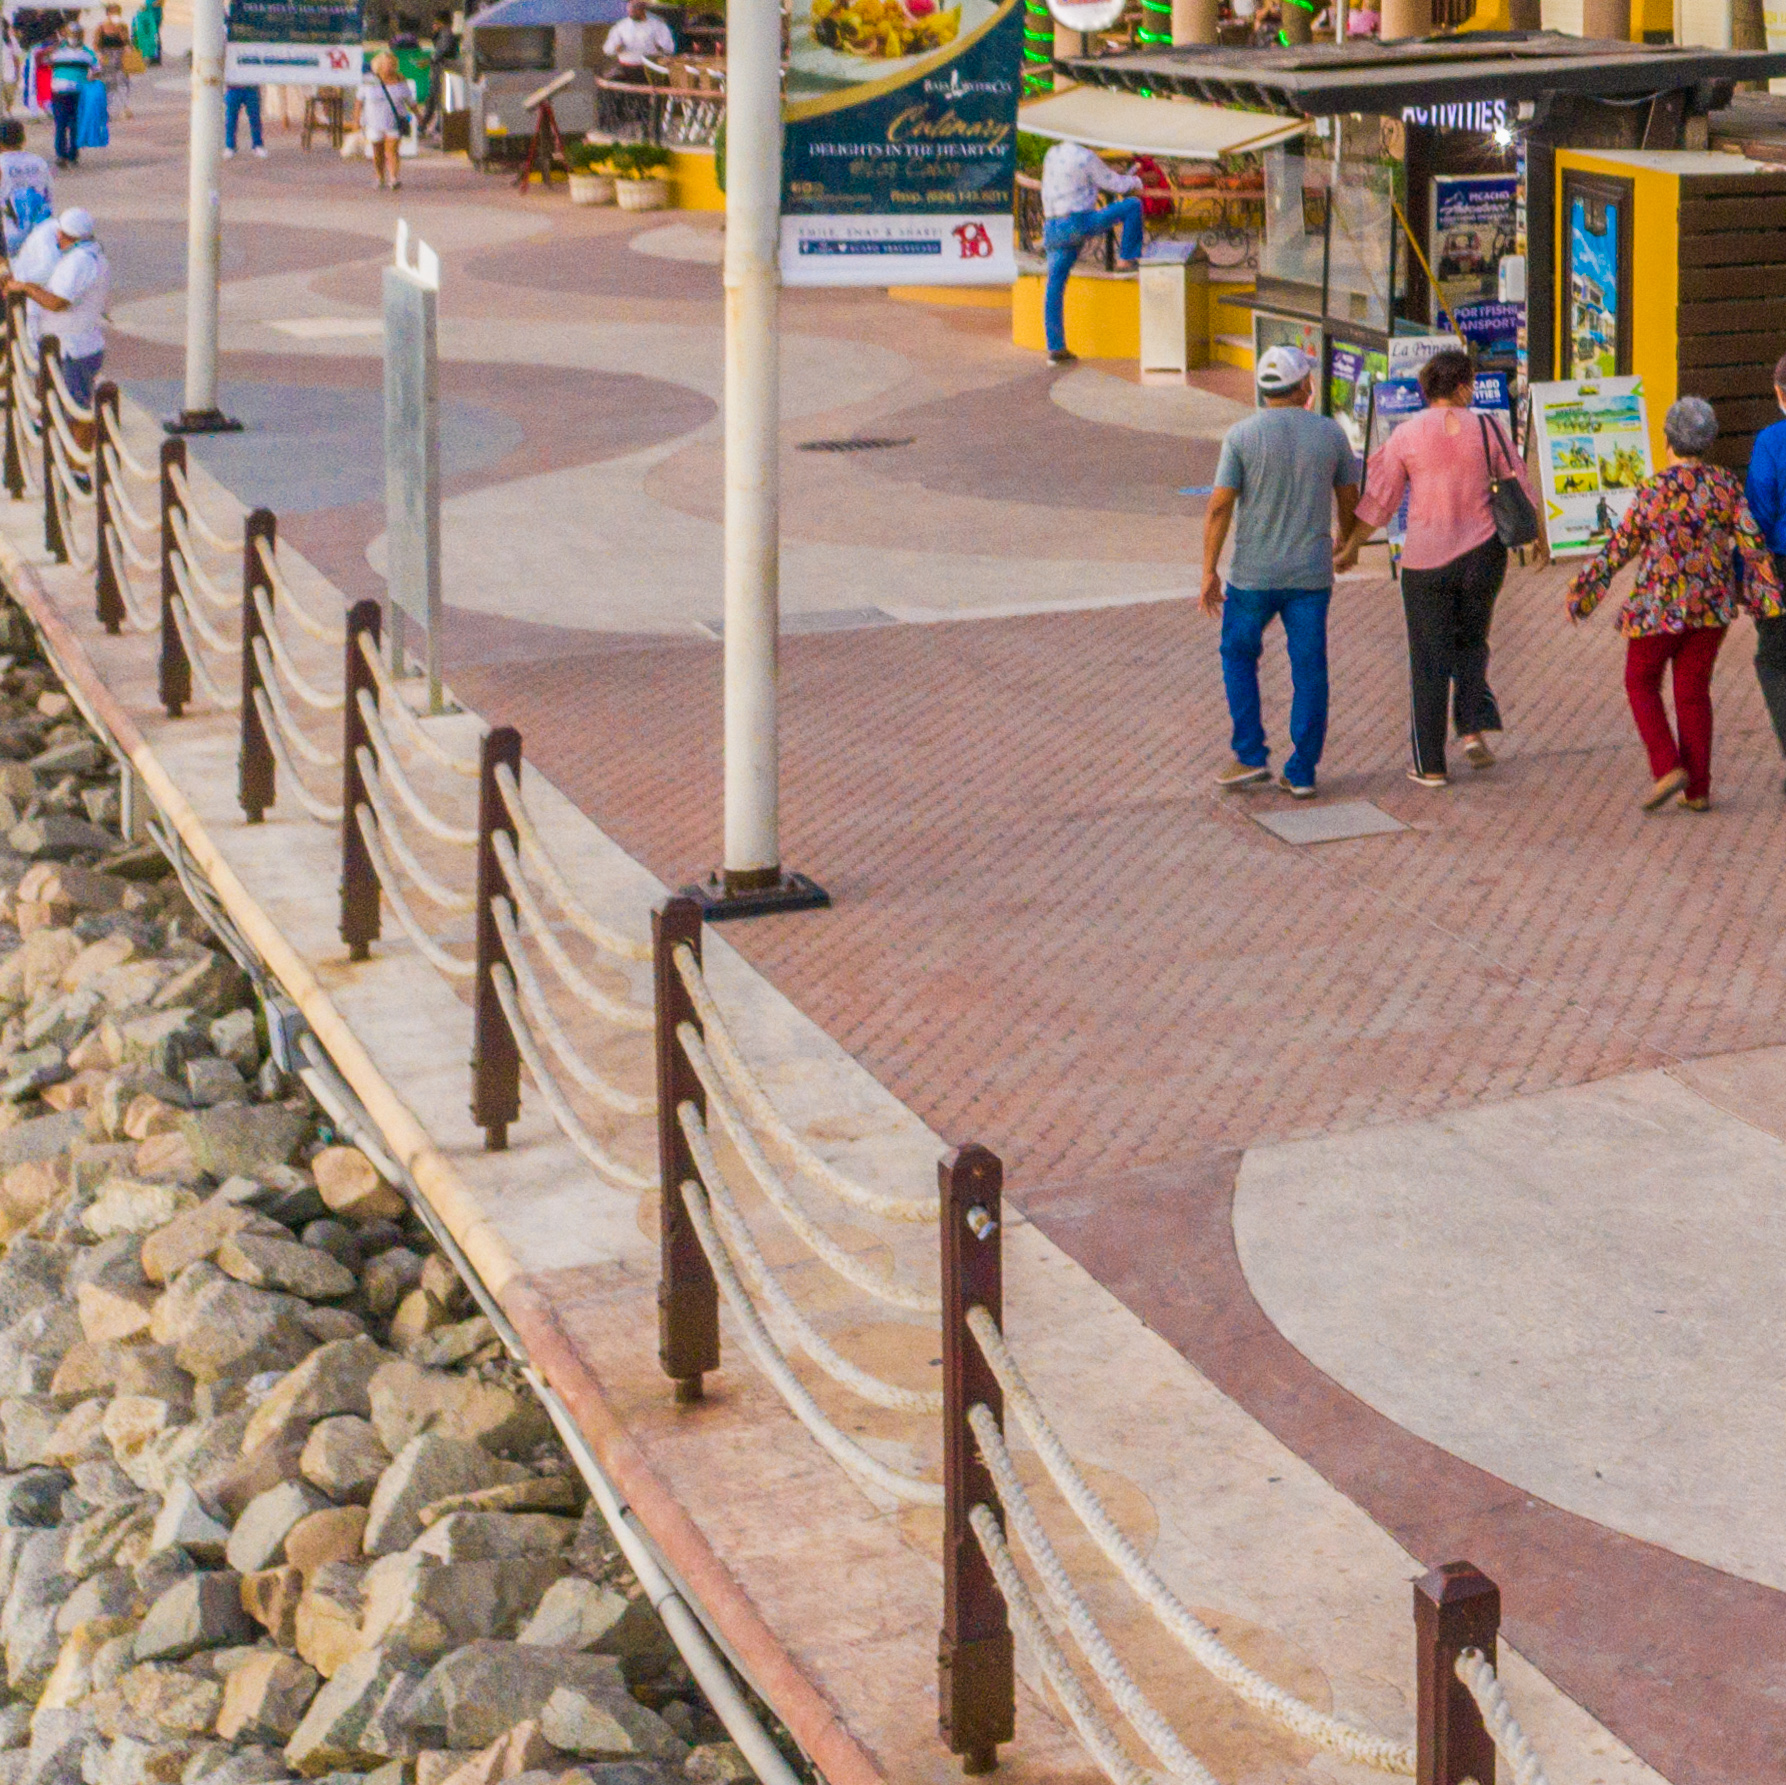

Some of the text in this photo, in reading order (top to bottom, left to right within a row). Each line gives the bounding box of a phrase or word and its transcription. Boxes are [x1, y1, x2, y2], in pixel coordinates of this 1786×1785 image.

[1402, 100, 1507, 133] ACTIVITIES
[808, 142, 882, 157] DELIGHTS
[886, 143, 901, 156] IN
[905, 142, 932, 157] THE
[936, 142, 986, 157] HEART
